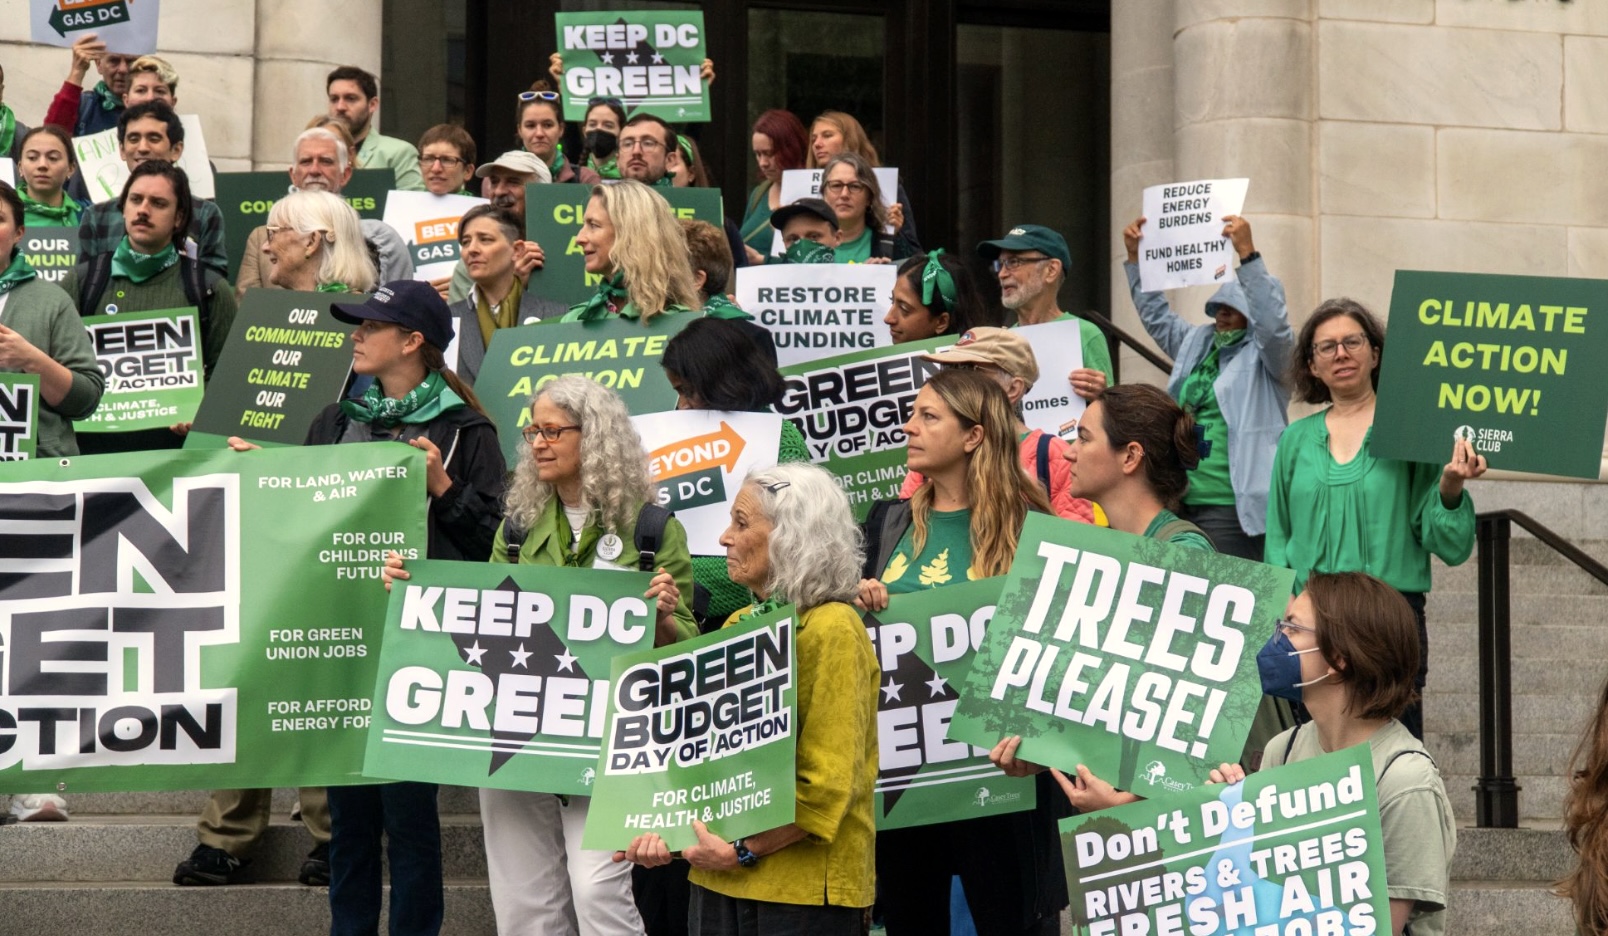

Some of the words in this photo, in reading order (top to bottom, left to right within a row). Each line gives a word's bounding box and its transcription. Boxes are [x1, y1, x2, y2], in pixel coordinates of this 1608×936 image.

[63, 12, 95, 26] GAS
[98, 6, 122, 20] DC
[564, 24, 648, 49] KEEP
[655, 24, 699, 48] DC
[565, 64, 701, 96] GREEN
[1163, 183, 1212, 199] REDUCE
[1162, 197, 1210, 213] ENERGY
[1159, 212, 1212, 229] BURDENS
[28, 239, 69, 251] OUR
[417, 244, 454, 260] GAS
[1145, 247, 1172, 261] FUND
[1175, 239, 1227, 257] HEALTHY
[1167, 258, 1203, 273] HOMES
[757, 287, 876, 303] RESTORE
[288, 308, 318, 325] OUR
[760, 309, 873, 326] CLIMATE
[1418, 299, 1588, 334] CLIMATE
[88, 319, 192, 356] EEN
[245, 325, 345, 349] COMMUNITIES
[773, 331, 875, 349] UNDING
[272, 349, 302, 366] OUR
[510, 335, 668, 367] CLIMATE
[1422, 340, 1568, 375] ACTION
[118, 374, 194, 390] ACTION
[247, 368, 311, 389] CLIMATE
[256, 390, 286, 408] OUR
[1437, 382, 1541, 416] NOW!
[105, 413, 116, 421] &
[119, 406, 177, 421] JUSTICE
[240, 410, 285, 430] FIGHT
[837, 435, 866, 453] OF
[1478, 428, 1513, 442] SIERRA
[1476, 440, 1501, 453] CLUB
[258, 477, 292, 488] FOR
[296, 474, 344, 488] LAND,
[348, 466, 408, 482] WATER
[856, 464, 907, 485] CLIMA
[313, 490, 326, 502] &
[329, 486, 357, 500] AIR
[678, 477, 713, 500] DC
[871, 487, 883, 500] &
[333, 533, 366, 545] FOR
[369, 532, 405, 545] OUR
[400, 585, 555, 637] KEEP
[567, 594, 648, 644] DC
[1022, 541, 1255, 682] TREES
[270, 629, 304, 642] FOR
[307, 628, 363, 641] GREEN
[266, 646, 320, 660] UNION
[323, 644, 367, 658] JOBS
[618, 623, 789, 712] GREEN
[990, 635, 1228, 759] PLEASE!
[268, 701, 301, 714] FOR
[613, 673, 789, 750] BUDGET
[272, 717, 339, 732] ENERGY
[610, 747, 671, 770] DAY
[679, 739, 708, 762] OF
[715, 713, 788, 754] ACTION
[652, 789, 687, 807] FOR
[690, 771, 756, 802] CLIMATE,
[624, 811, 698, 829] HEALTH
[701, 807, 713, 823] &
[716, 788, 771, 819] JUSTICE
[1075, 809, 1191, 868] Don't
[1201, 764, 1363, 838] Defund
[1085, 866, 1207, 918] RIVERS
[1217, 858, 1241, 888] &
[1250, 827, 1368, 879] TREES
[1279, 860, 1373, 918] AIR
